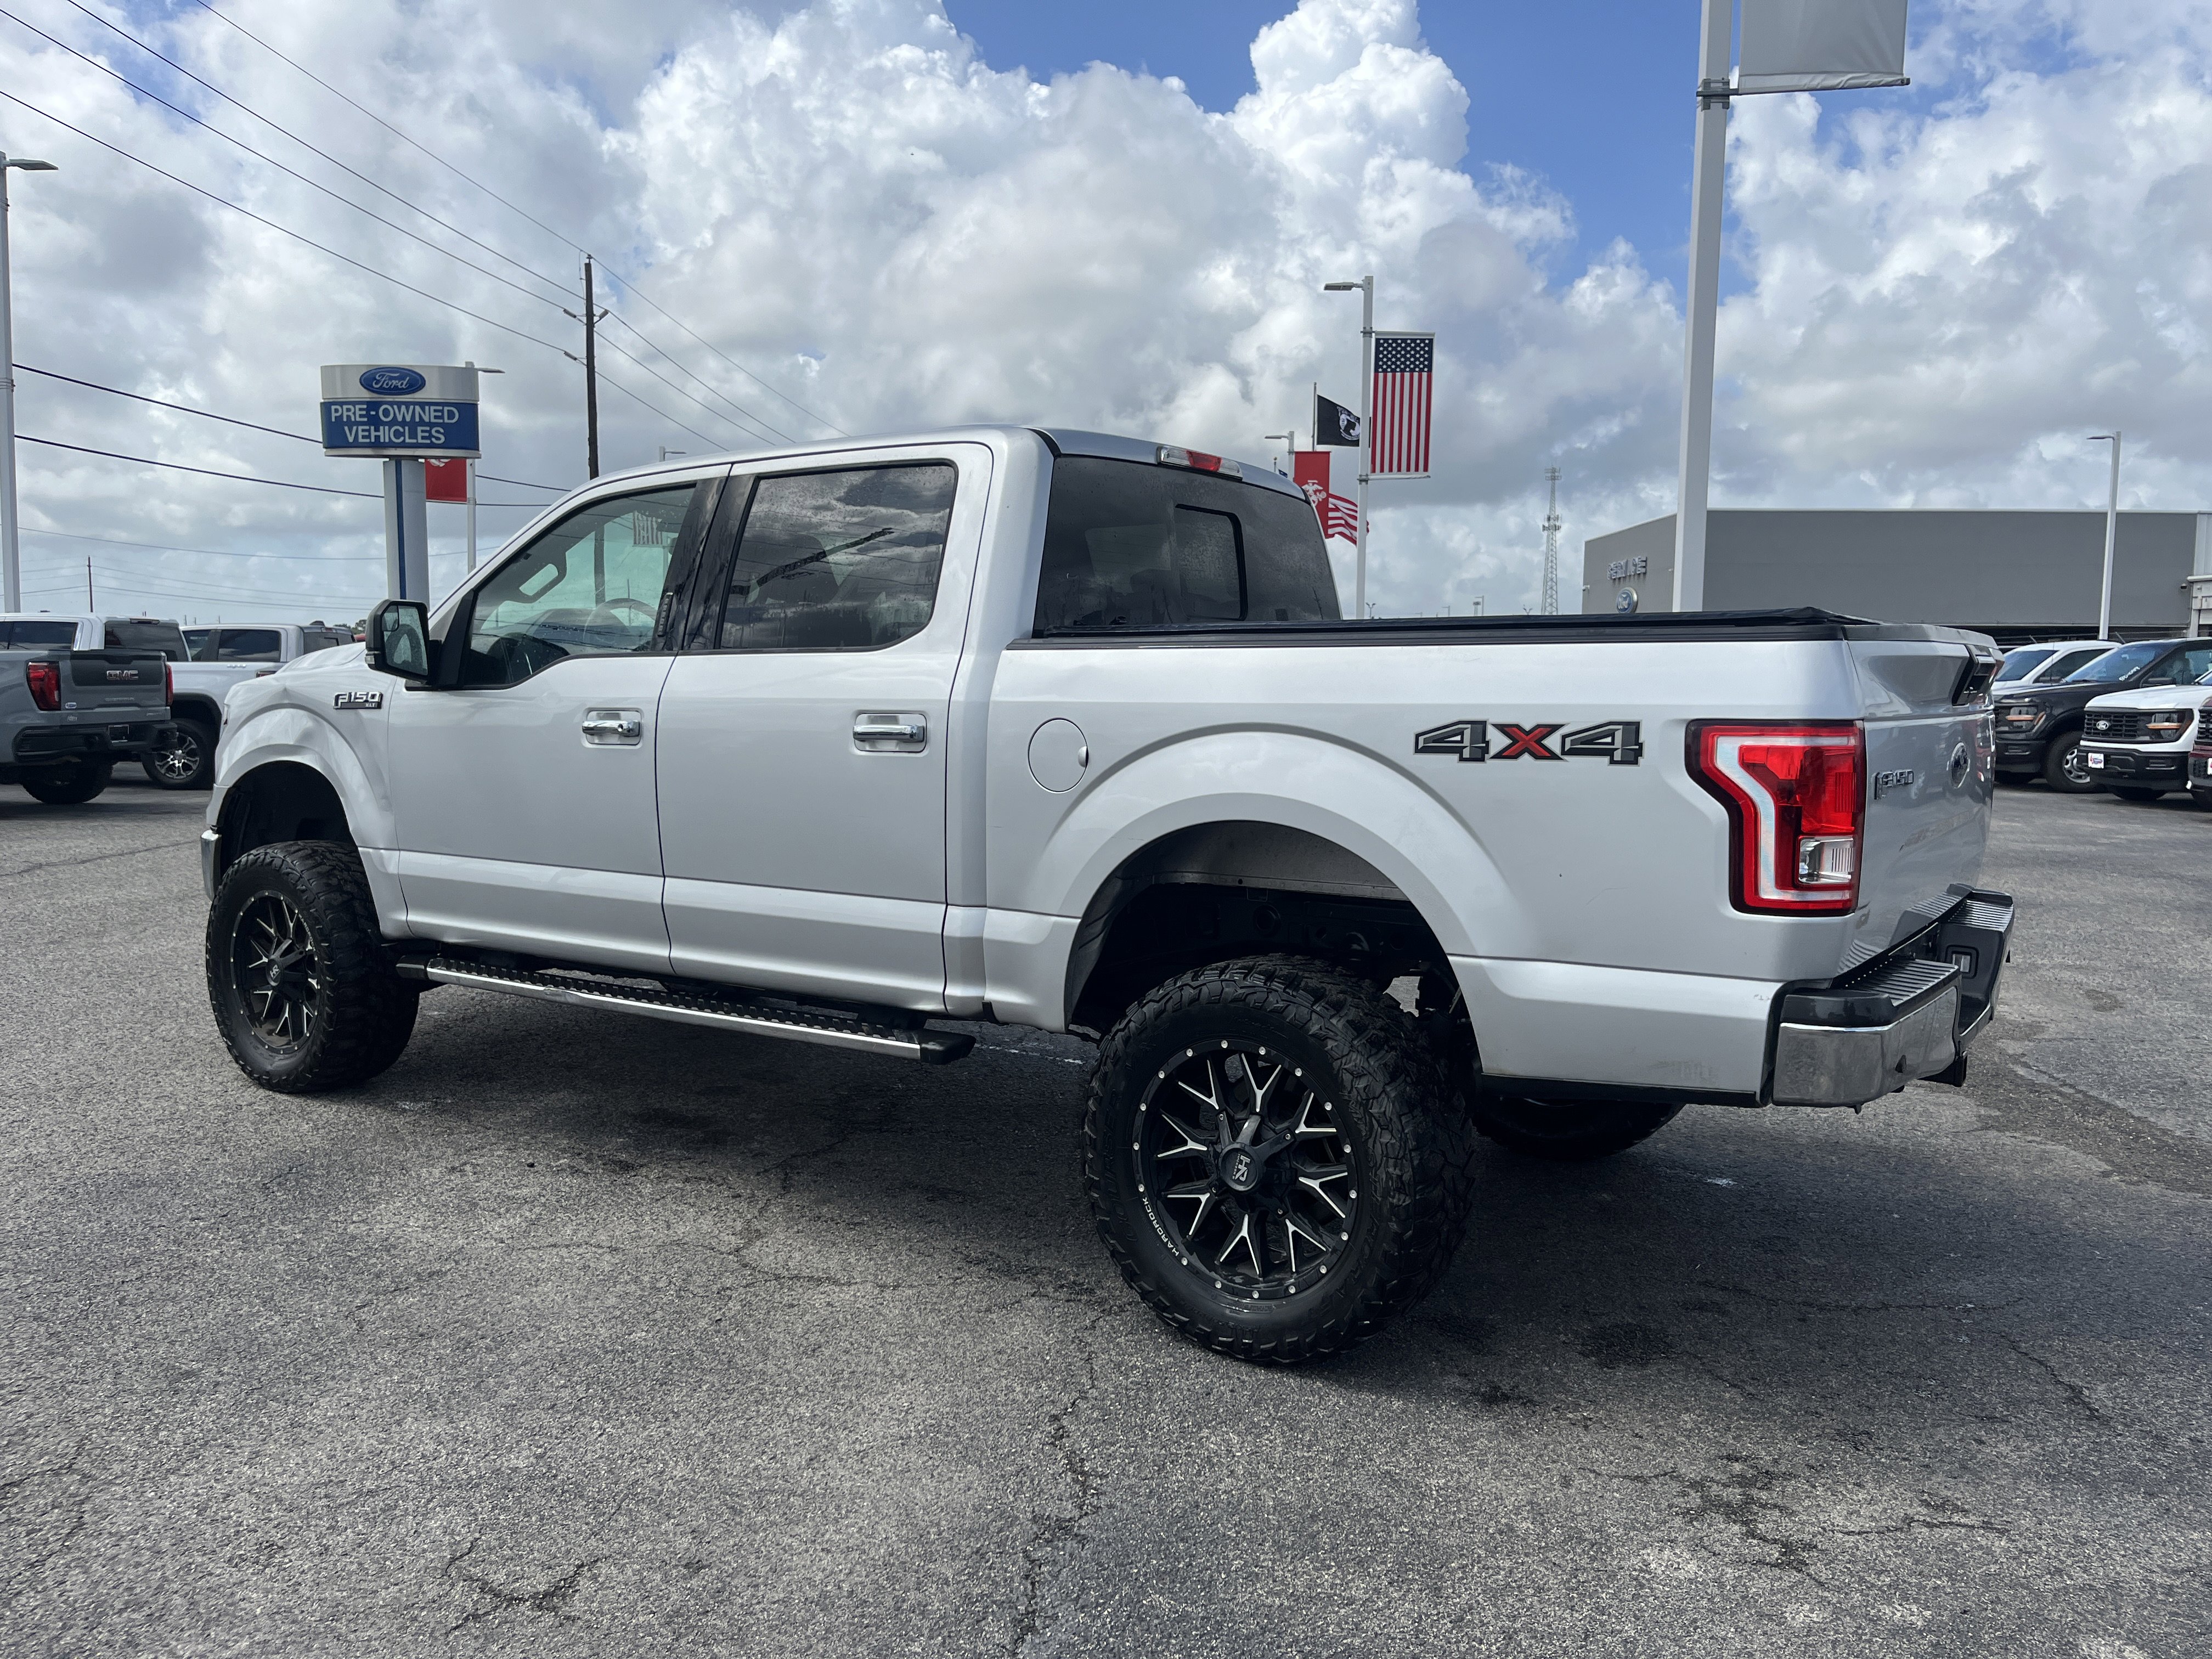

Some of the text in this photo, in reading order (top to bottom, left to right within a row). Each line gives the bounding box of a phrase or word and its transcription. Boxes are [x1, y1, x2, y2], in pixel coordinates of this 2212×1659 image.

[373, 372, 410, 388] Ford
[344, 426, 445, 444] VEHICLES
[106, 670, 139, 680] GMC
[1142, 1197, 1180, 1257] HARDROCK
